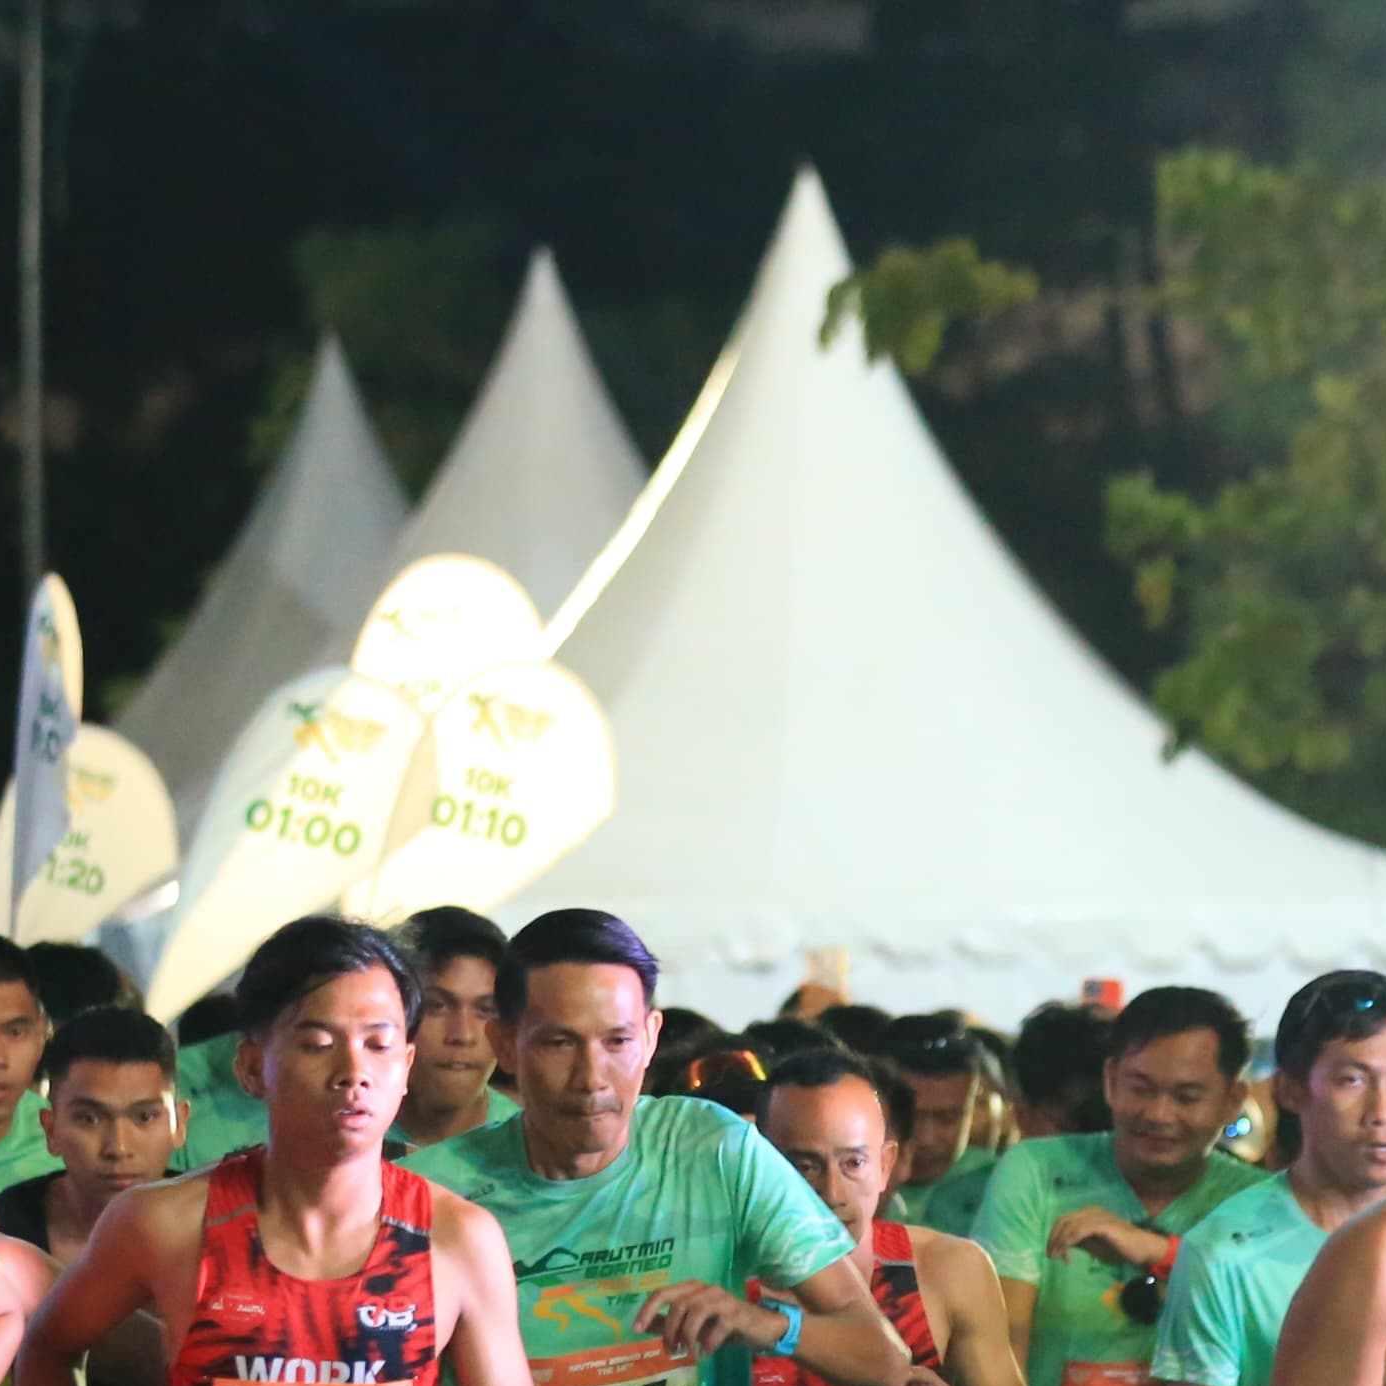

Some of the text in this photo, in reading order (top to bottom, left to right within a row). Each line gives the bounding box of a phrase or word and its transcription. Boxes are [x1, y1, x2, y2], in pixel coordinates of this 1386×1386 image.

[288, 773, 343, 807] 10K
[466, 766, 515, 799] 10K
[245, 798, 362, 856] 01:00
[431, 795, 528, 847] 01:10
[45, 853, 106, 895] 1:20
[579, 1237, 676, 1266] ARUTMIN
[584, 1255, 673, 1280] BORNEO
